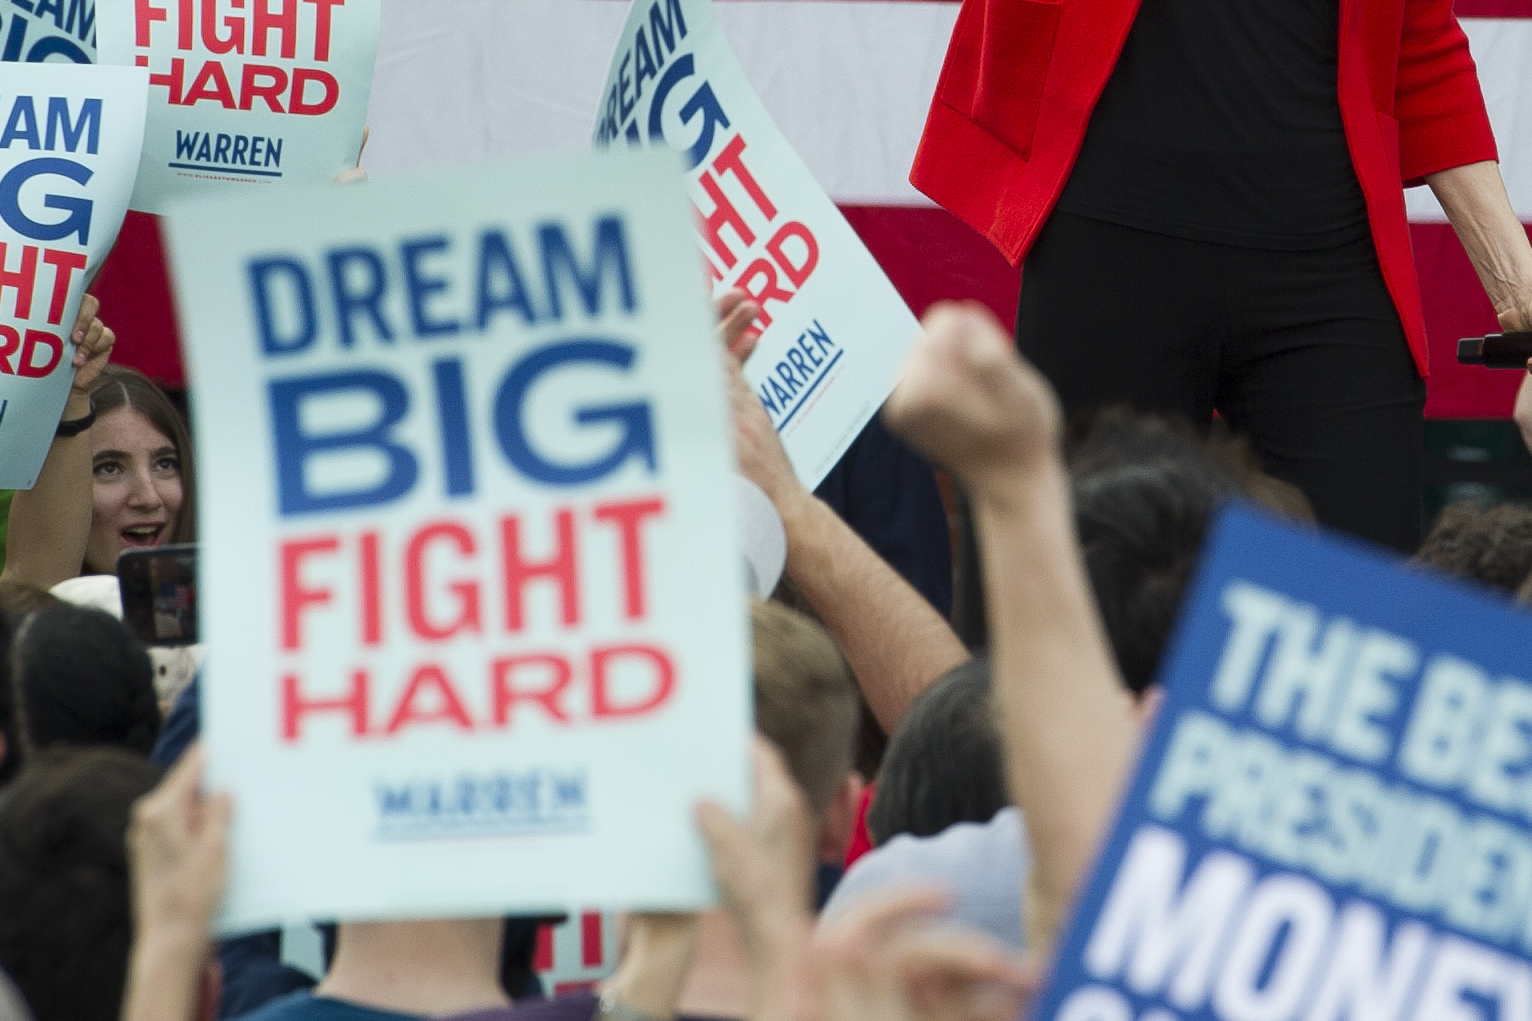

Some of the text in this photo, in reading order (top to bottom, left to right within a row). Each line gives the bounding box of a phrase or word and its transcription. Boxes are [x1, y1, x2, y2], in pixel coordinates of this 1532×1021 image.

[136, 56, 339, 116] HARD
[176, 130, 283, 167] WARREN
[242, 209, 642, 361] DREAM
[264, 335, 658, 519] BIG
[277, 496, 668, 655] FIGHT
[280, 643, 680, 744] HARD
[1206, 580, 1418, 766] THE
[372, 766, 590, 818] WARREN
